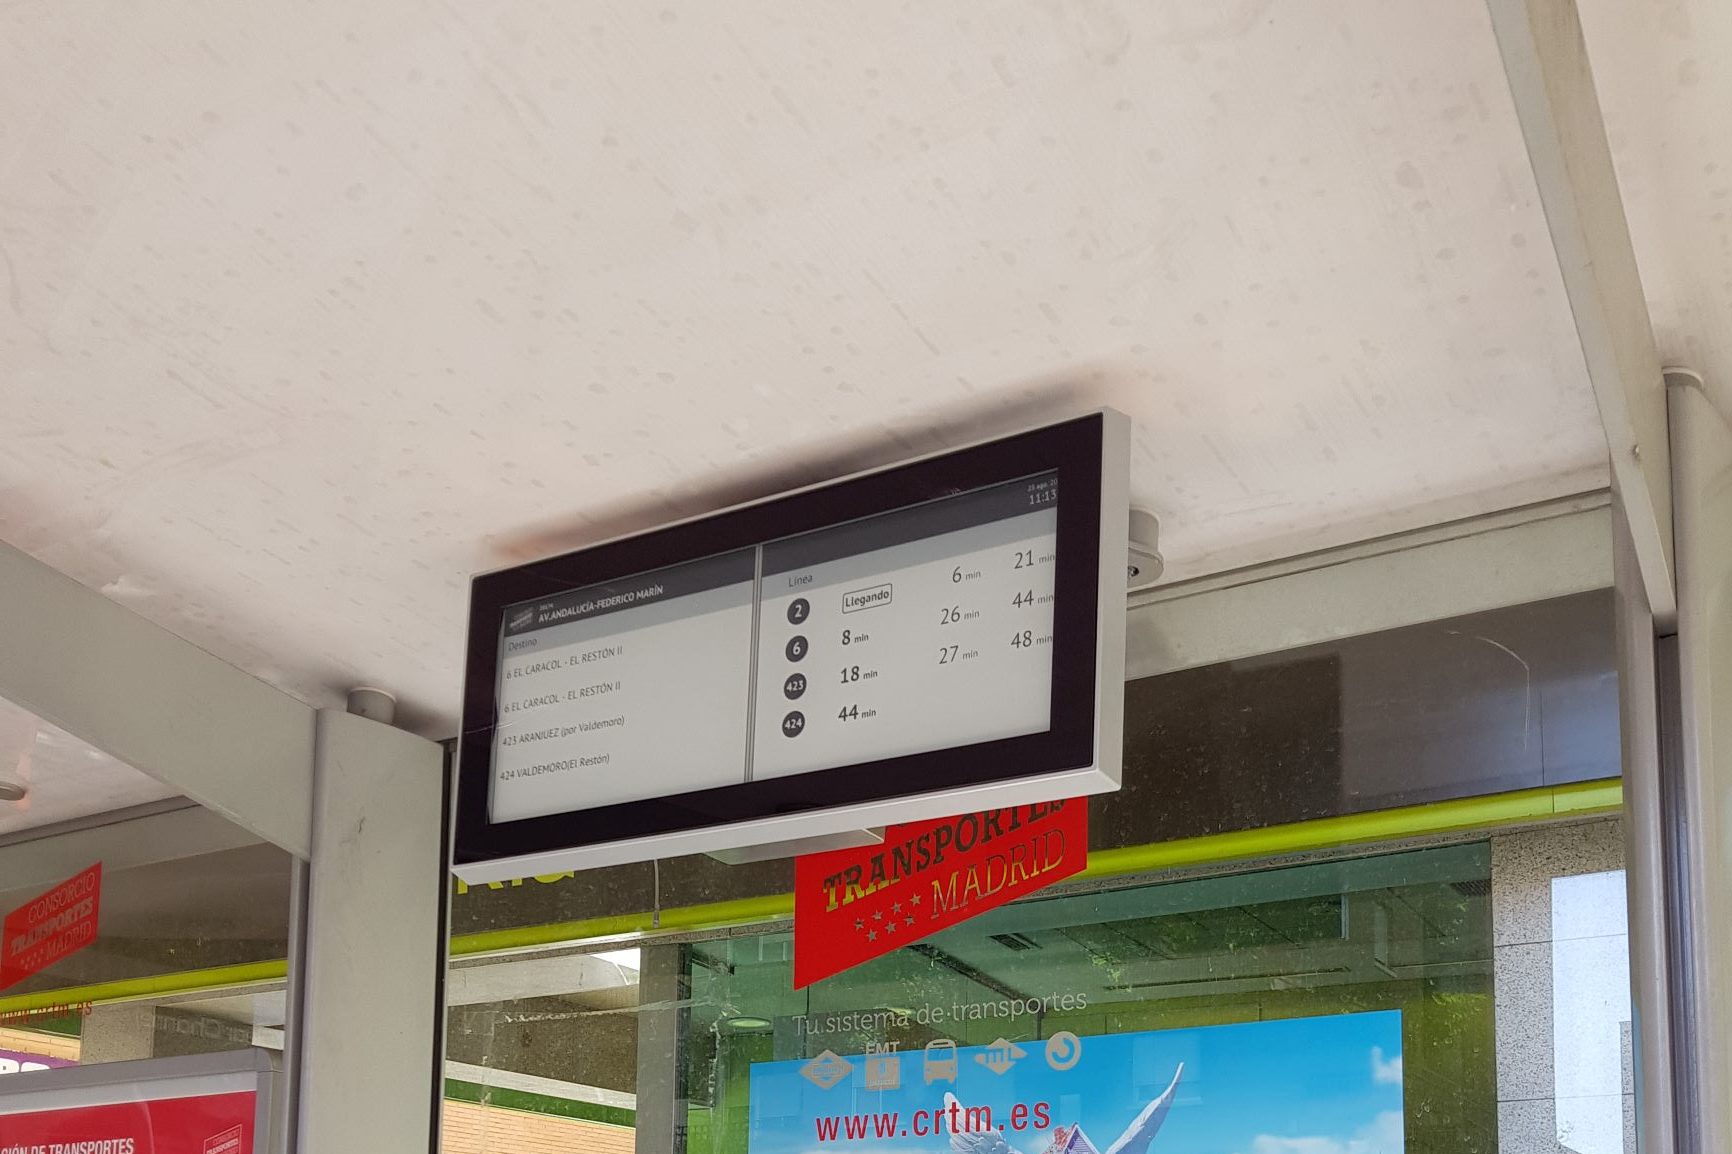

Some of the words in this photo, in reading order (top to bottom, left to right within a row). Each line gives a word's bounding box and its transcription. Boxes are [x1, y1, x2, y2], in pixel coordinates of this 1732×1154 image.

[1029, 488, 1057, 505] 11:13
[636, 584, 664, 602] MARÍN
[788, 574, 813, 587] Línea
[794, 605, 802, 618] 2
[845, 590, 890, 608] Llegando
[952, 566, 962, 583] 6
[965, 570, 981, 581] min
[1014, 550, 1034, 570] 21
[1038, 553, 1055, 564] min
[792, 642, 801, 655] 6
[842, 629, 851, 646] 8
[854, 633, 869, 644] min
[940, 606, 961, 625] 26
[964, 610, 980, 621] min
[1012, 589, 1034, 609] 44
[1037, 594, 1054, 605] min
[508, 639, 538, 652] Destino
[514, 668, 522, 678] EL
[525, 660, 562, 675] CARACOL
[569, 656, 580, 666] EL
[786, 680, 804, 692] 423
[840, 665, 860, 684] 18
[863, 669, 878, 680] min
[938, 645, 959, 665] 27
[962, 649, 979, 661] min
[1011, 630, 1033, 649] 48
[1036, 635, 1053, 645] min
[512, 701, 521, 712] EL
[523, 694, 560, 709] CARACOL
[567, 690, 577, 700] EL
[502, 735, 517, 746] 423
[519, 728, 560, 744] ARANJUEZ
[561, 725, 577, 738] (por
[578, 715, 625, 733] Valdemoro)
[784, 718, 802, 729] 424
[838, 704, 859, 722] 44
[861, 709, 877, 719] min
[500, 770, 515, 781] 424
[930, 828, 1066, 920] MADRID
[28, 872, 95, 923] CONSORCIO
[47, 920, 92, 961] MADRID
[792, 1015, 820, 1036] Tu
[826, 1008, 909, 1033] sistema
[916, 1003, 944, 1025] de
[952, 992, 1088, 1022] transportes
[865, 1041, 899, 1056] EMT
[815, 1101, 1051, 1141] www.crtm.es
